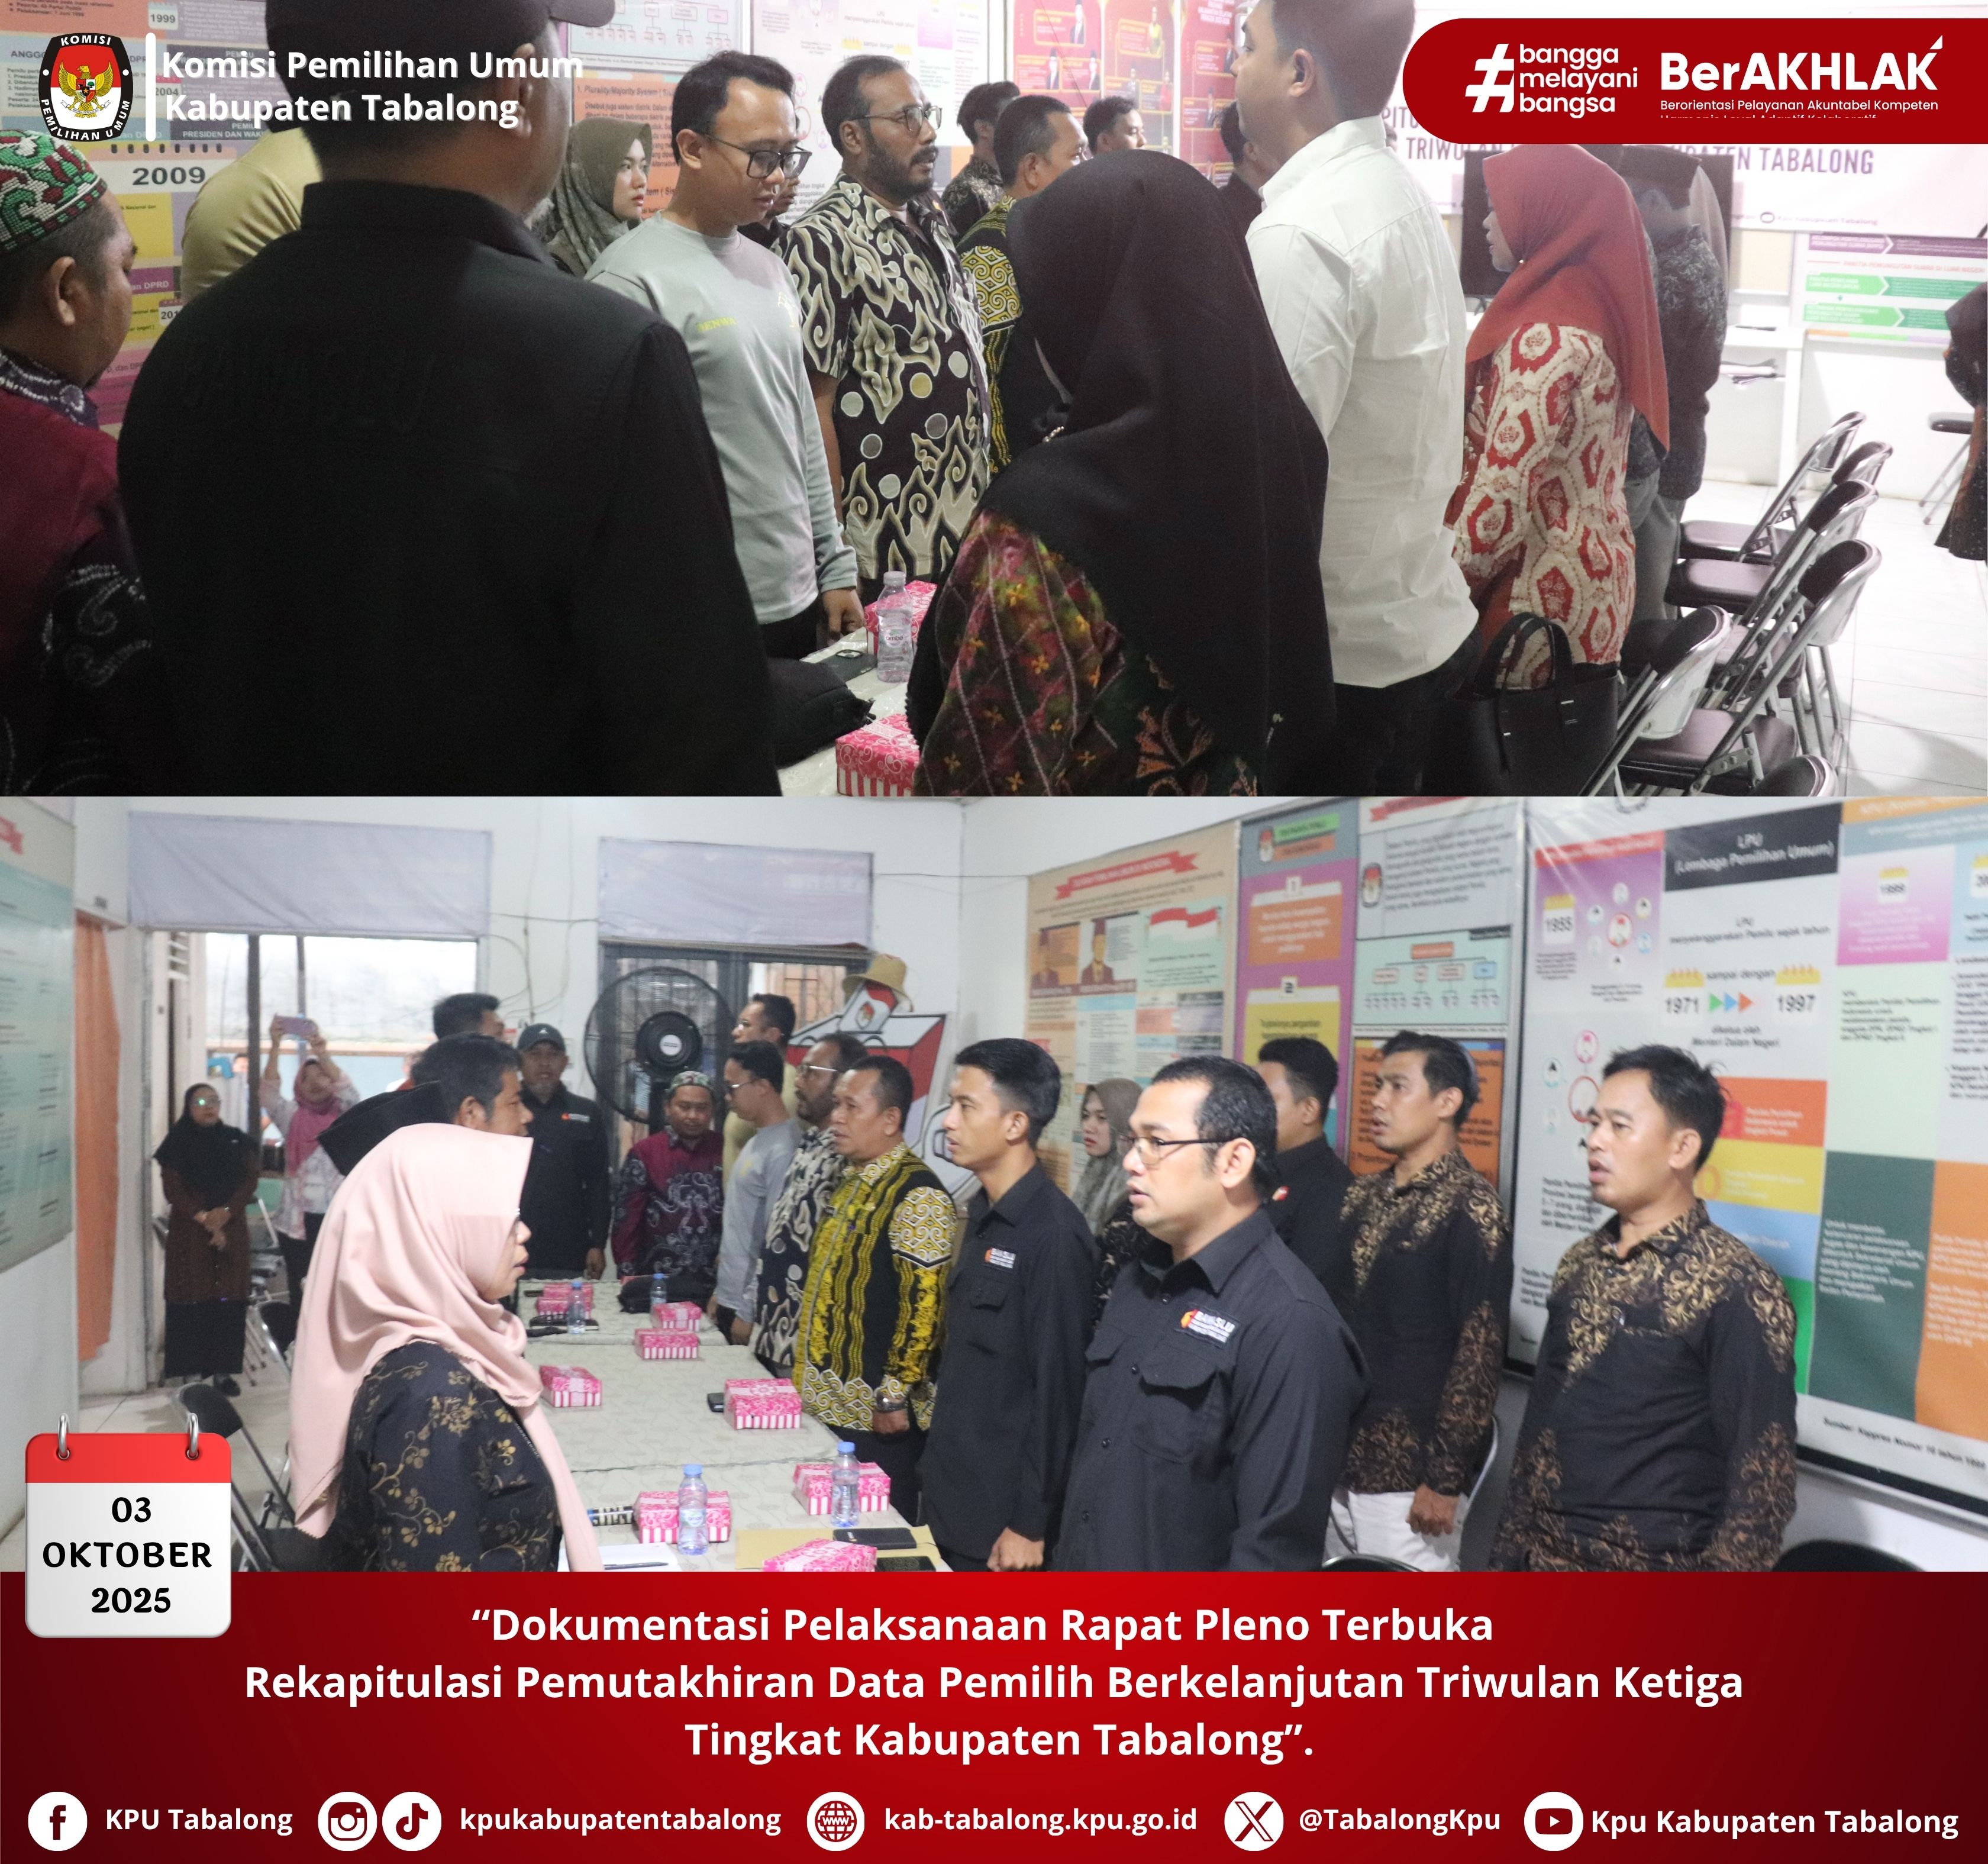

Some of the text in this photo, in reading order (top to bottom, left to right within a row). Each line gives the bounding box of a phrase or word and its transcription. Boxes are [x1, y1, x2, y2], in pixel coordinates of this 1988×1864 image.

[150, 14, 176, 23] 1999
[155, 88, 179, 96] 2004
[1759, 147, 1874, 174] TABALONG
[133, 166, 206, 185] 2009
[144, 280, 169, 289] DPRD
[160, 310, 179, 320] 201
[1664, 992, 1816, 1014] 1971 1997
